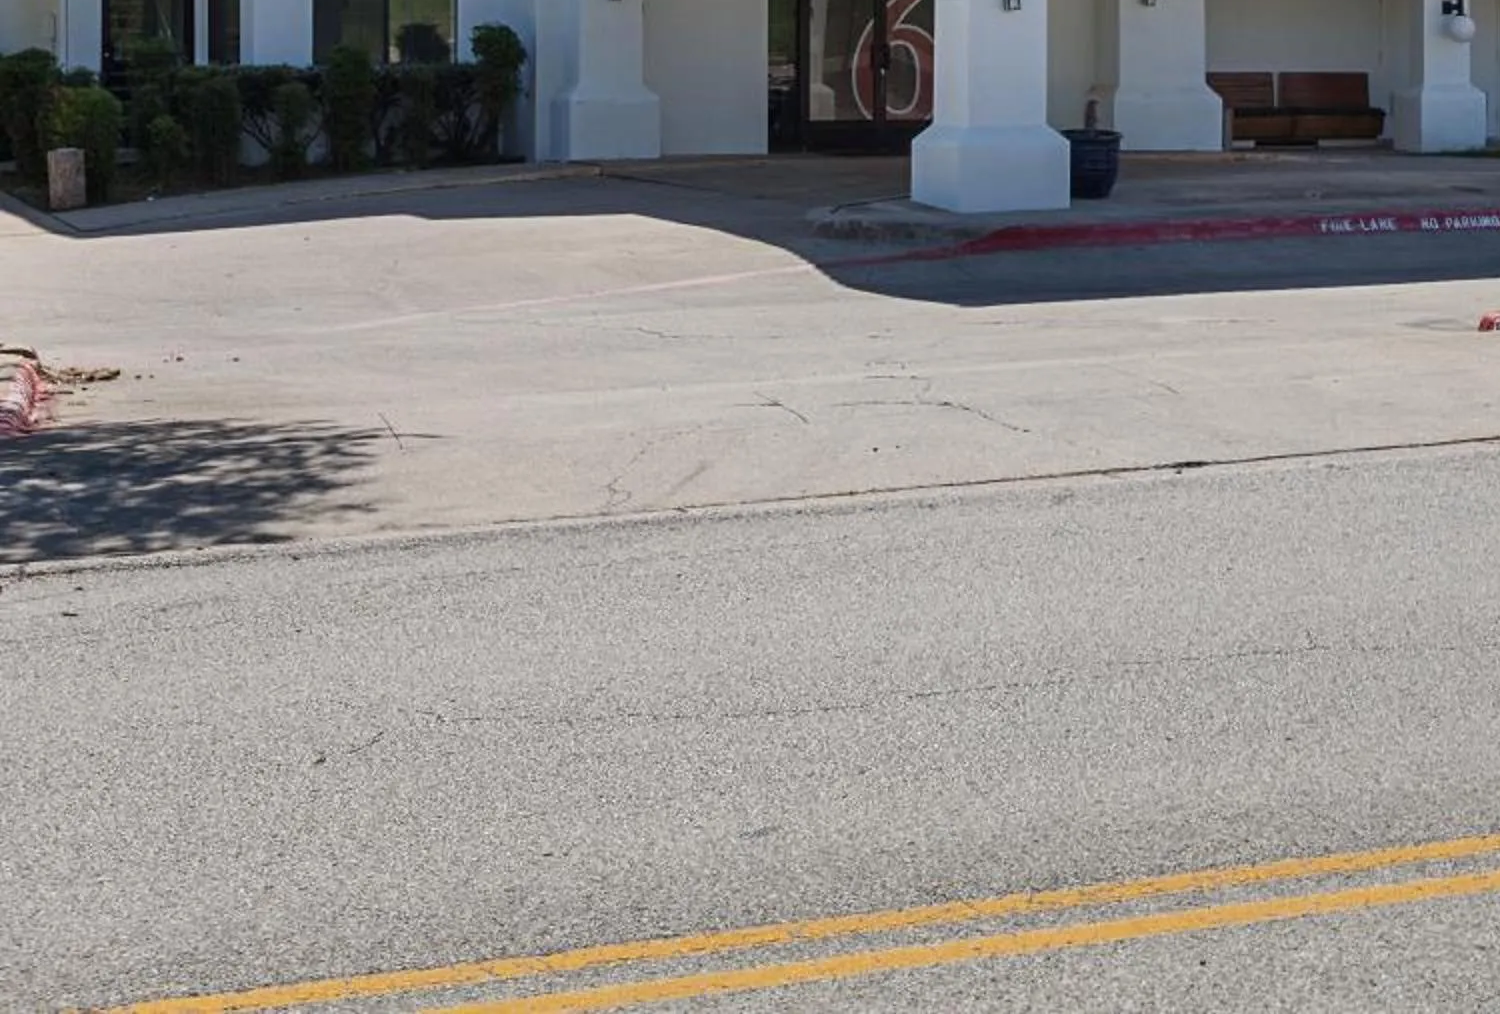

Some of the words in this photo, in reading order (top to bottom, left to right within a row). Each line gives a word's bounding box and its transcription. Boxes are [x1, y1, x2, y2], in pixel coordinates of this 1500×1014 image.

[1320, 217, 1354, 233] FIRE
[1359, 217, 1397, 232] LANE
[1420, 217, 1439, 230] NO
